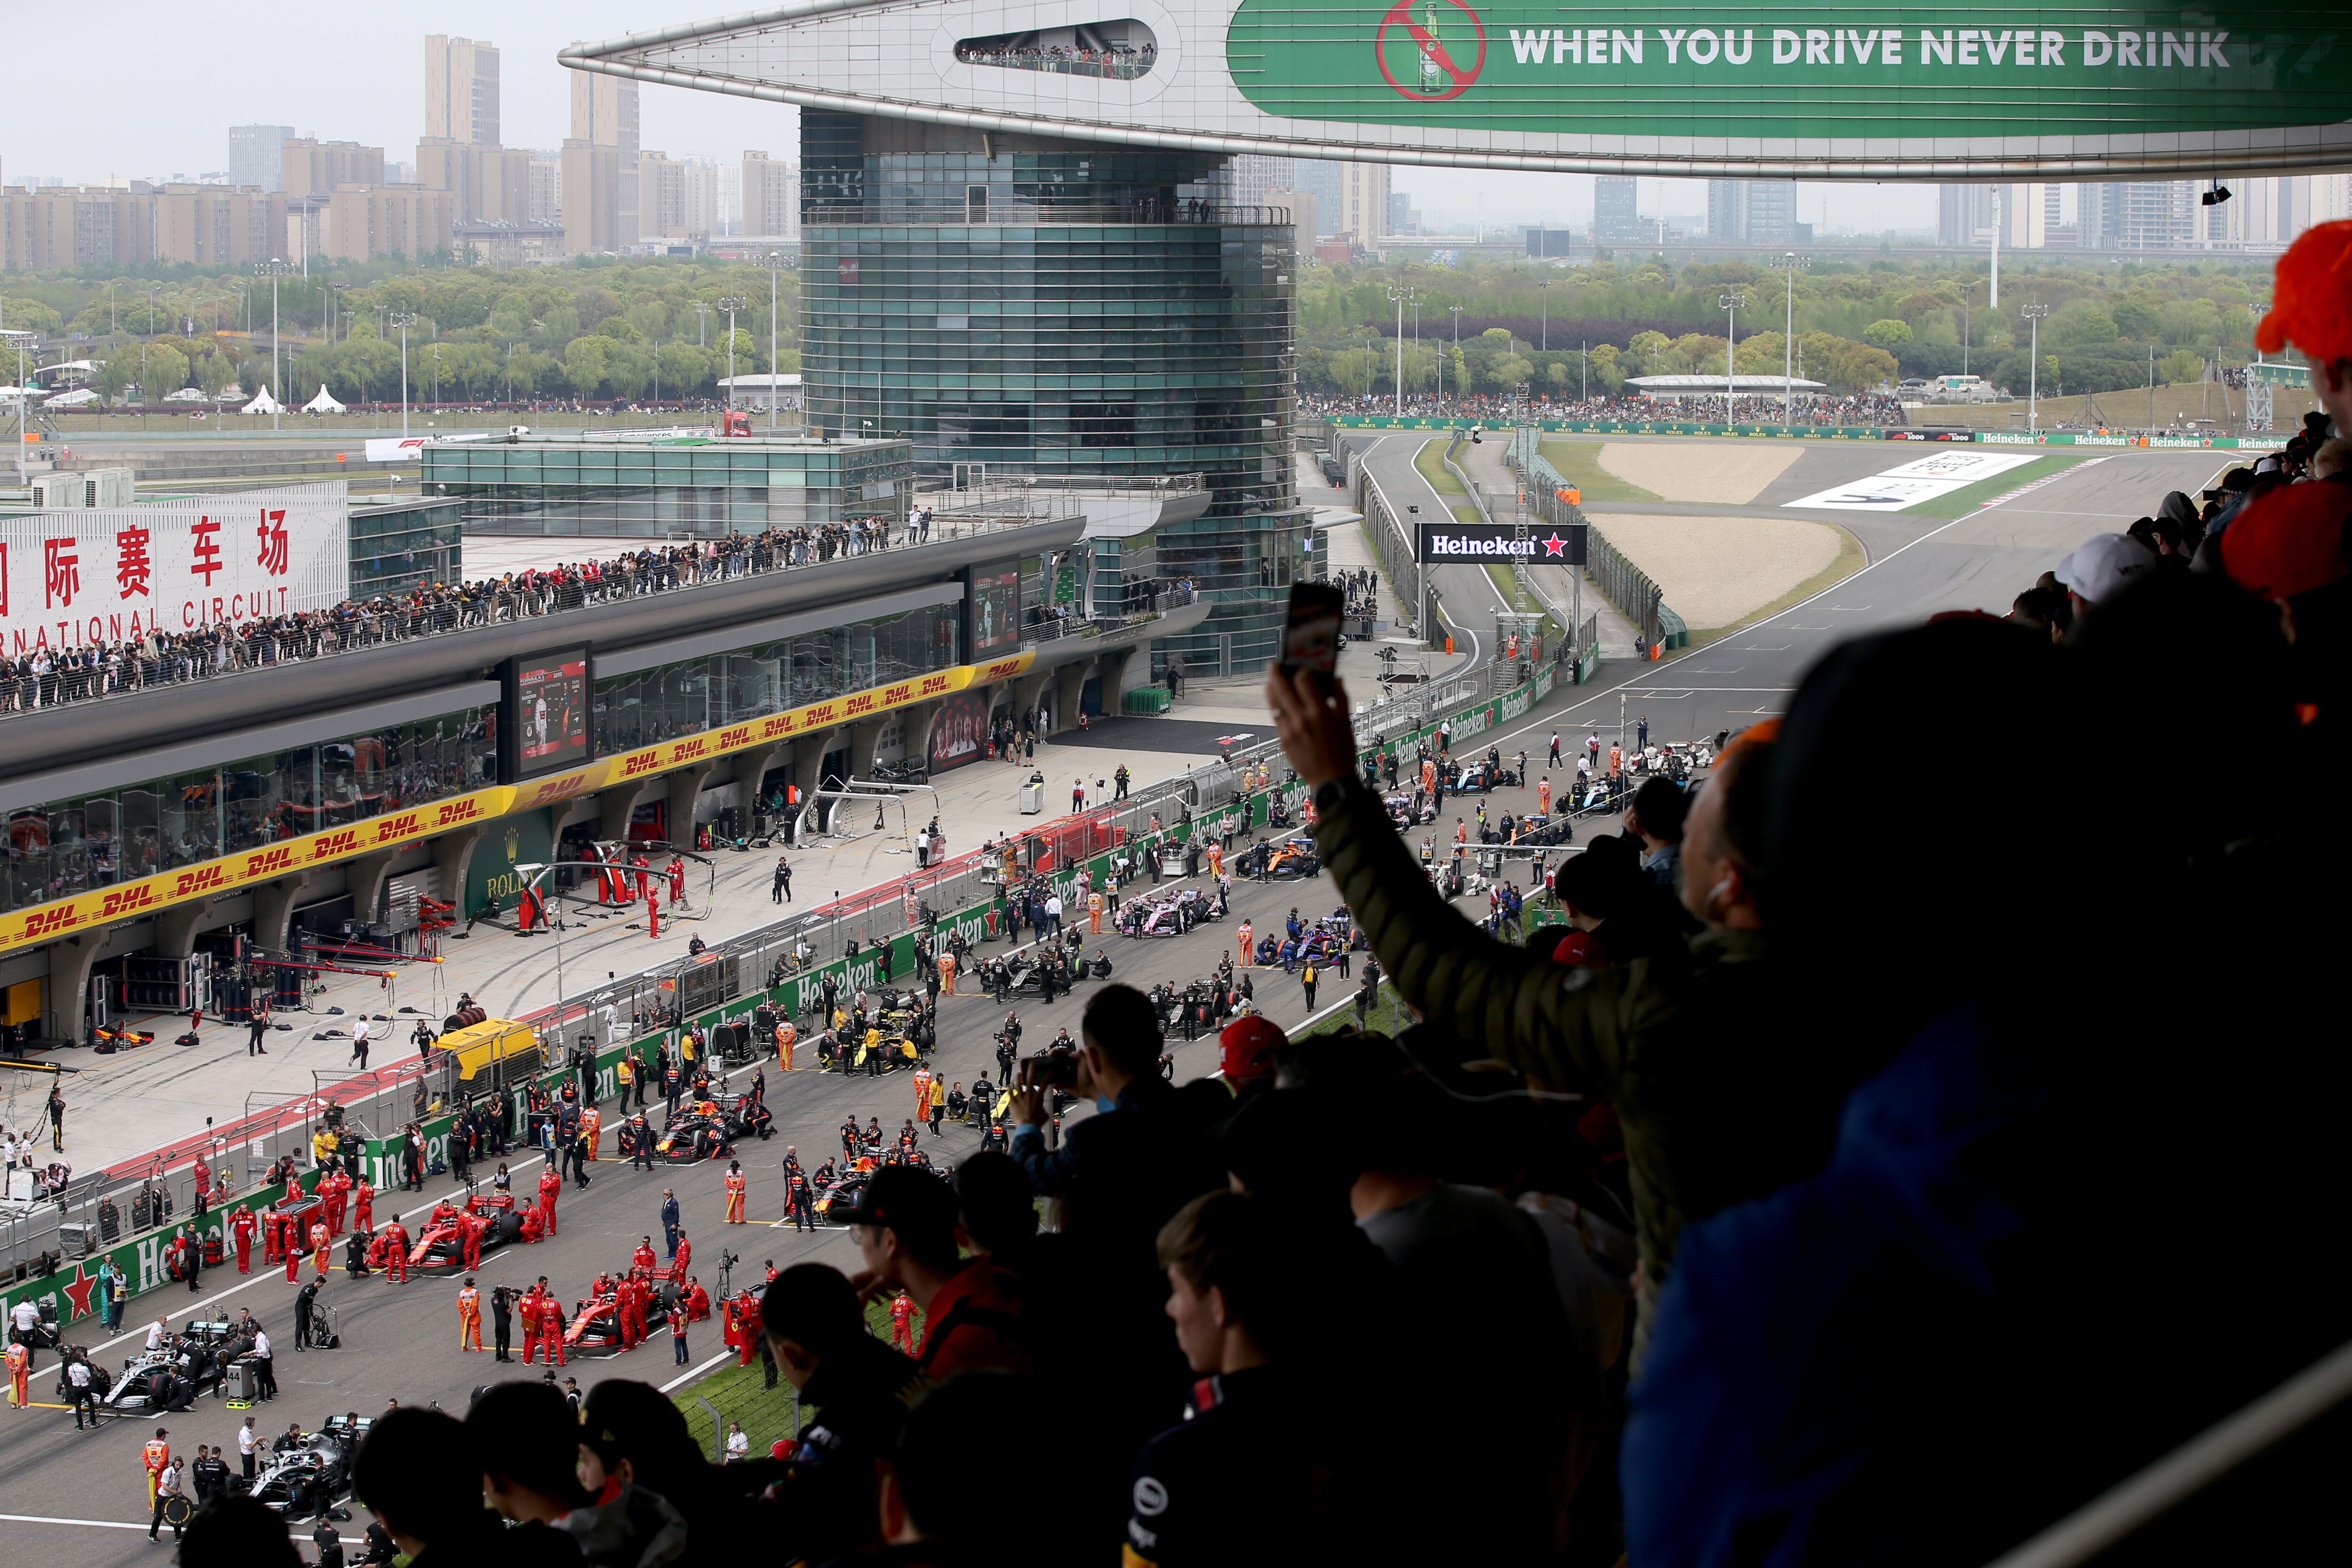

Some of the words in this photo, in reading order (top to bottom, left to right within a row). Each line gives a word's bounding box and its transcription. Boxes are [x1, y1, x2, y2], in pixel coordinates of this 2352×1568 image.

[1510, 29, 1643, 64] WHEN
[1660, 28, 1753, 64] YOU
[1773, 29, 1902, 64] DRIVE
[1921, 30, 2064, 65] NEVER
[2083, 31, 2231, 67] DRINK
[1983, 433, 2034, 445] Heineken
[2075, 435, 2126, 447] Heineken
[2150, 436, 2200, 448] Heineken
[1432, 536, 1536, 555] Heineken
[0, 508, 288, 617] 际赛车场
[183, 586, 287, 628] CIRCUIT
[988, 659, 1019, 681] DHL
[885, 685, 911, 705] DHL
[922, 675, 946, 695] DHL
[806, 705, 834, 726] DHL
[847, 695, 874, 715] DHL
[1502, 690, 1528, 721] Heineken
[720, 727, 751, 749] DHL
[764, 716, 793, 737] DHL
[1451, 710, 1486, 743] Heineken
[674, 739, 705, 761] DHL
[626, 752, 659, 775] DHL
[532, 775, 585, 805] DHL
[439, 799, 477, 825] DHL
[378, 815, 420, 841] DHL
[315, 831, 358, 859] DHL
[247, 848, 293, 877] DHL
[177, 866, 225, 896] DHL
[102, 885, 153, 917] DHL
[25, 904, 78, 938] DHL
[228, 1372, 240, 1381] 44
